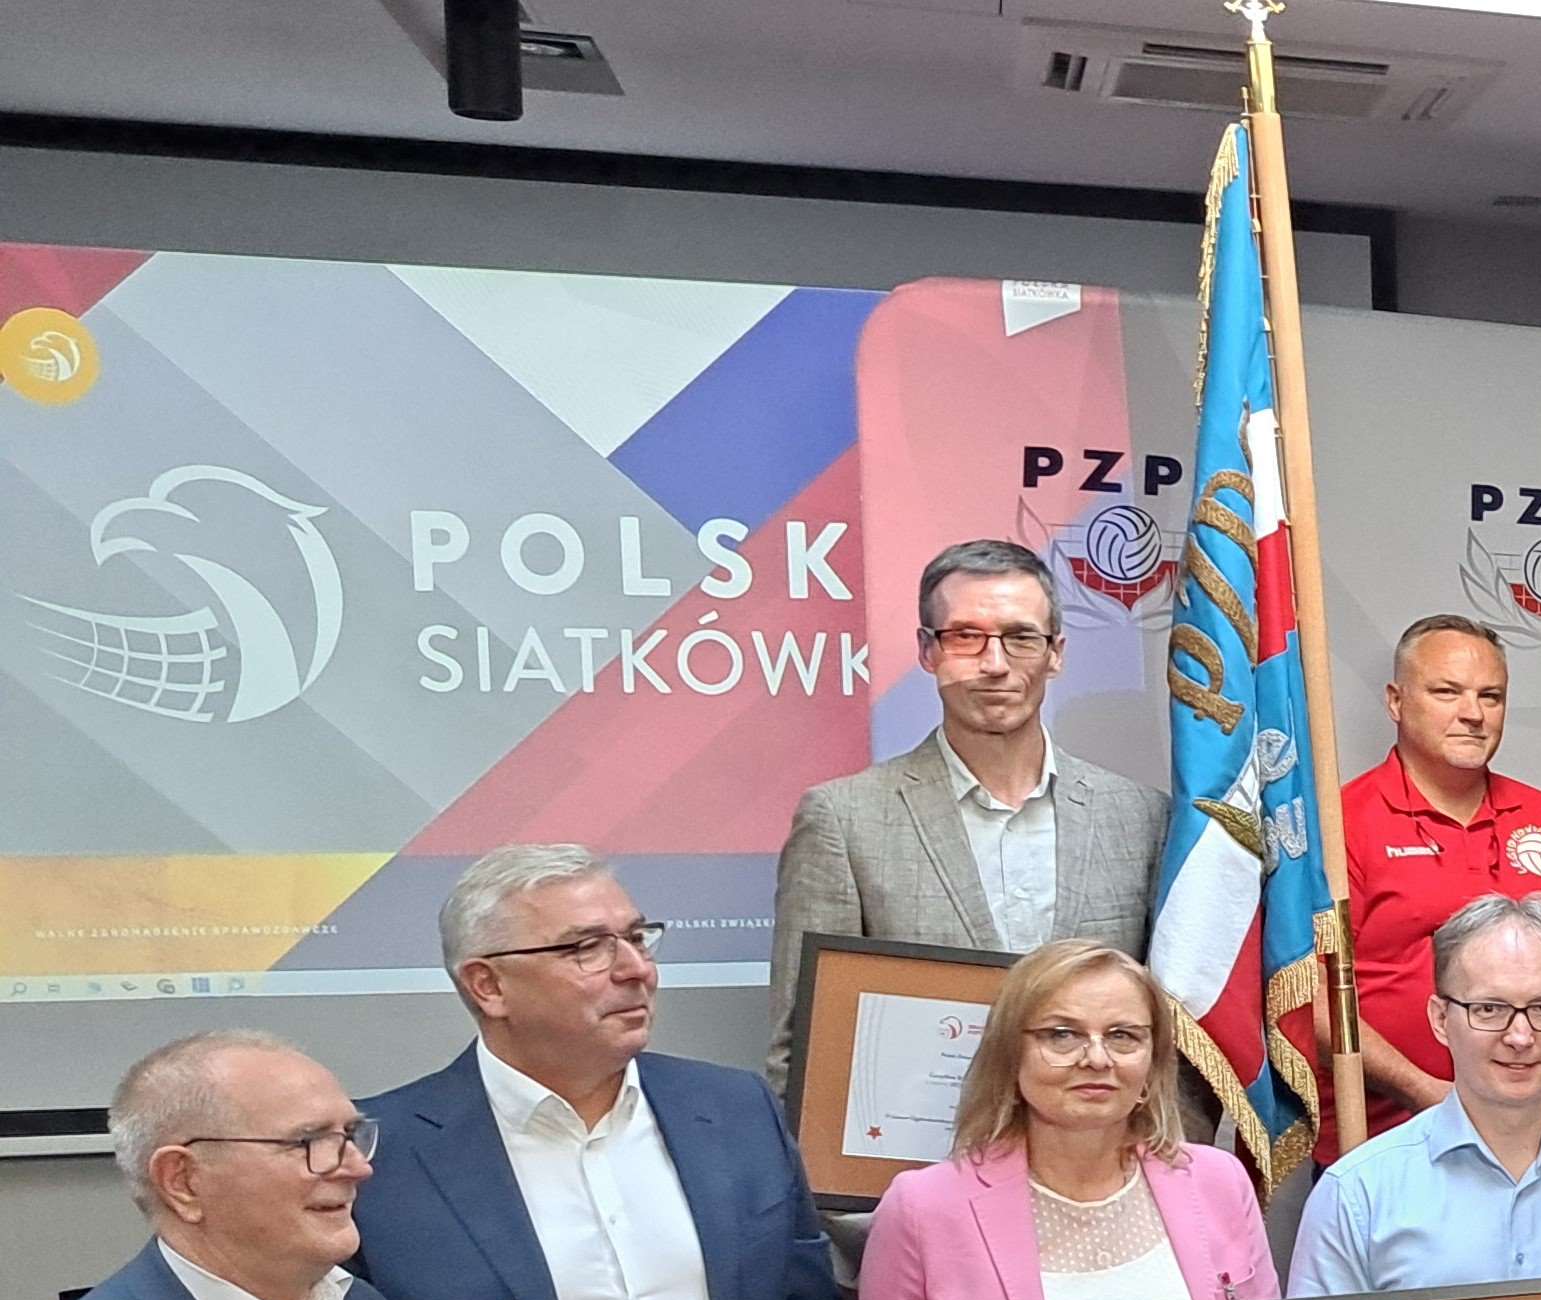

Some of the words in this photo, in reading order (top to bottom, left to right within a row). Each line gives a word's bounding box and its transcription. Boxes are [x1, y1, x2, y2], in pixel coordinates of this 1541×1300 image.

[1023, 446, 1184, 496] PZP
[409, 509, 854, 600] POLSK
[417, 610, 872, 698] SIATKÓWK
[667, 918, 716, 929] POLSKI
